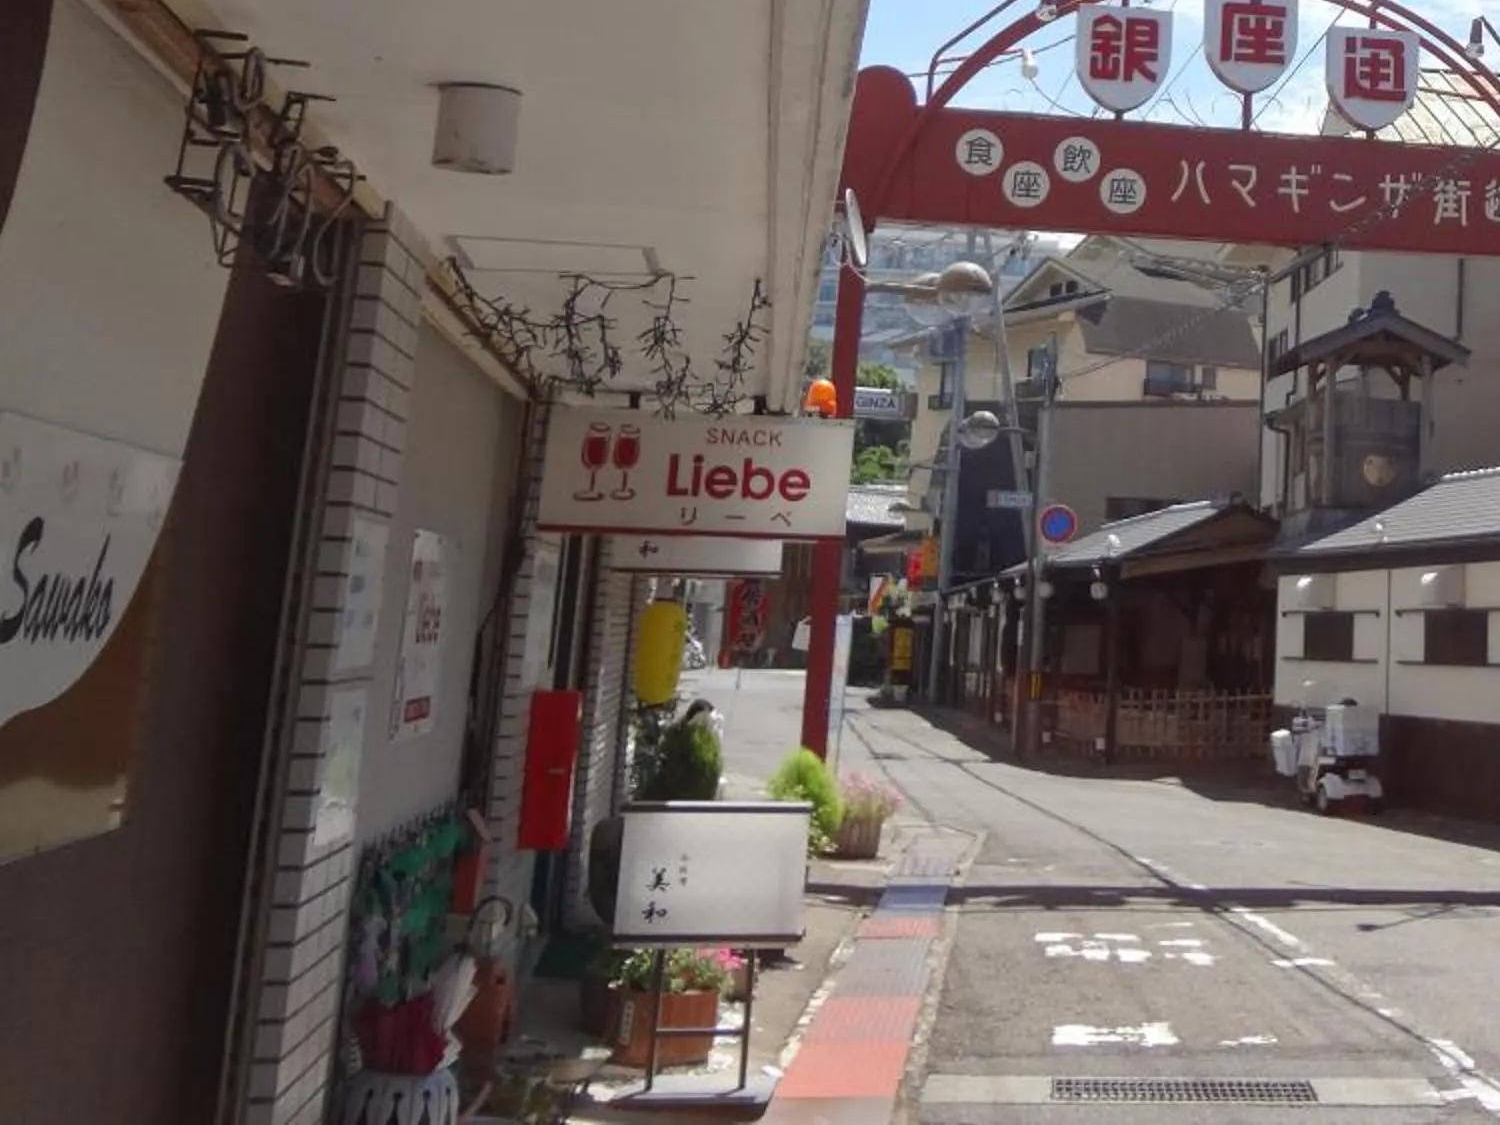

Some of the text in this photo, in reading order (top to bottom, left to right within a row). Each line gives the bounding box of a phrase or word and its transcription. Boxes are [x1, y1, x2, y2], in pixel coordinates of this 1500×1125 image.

[705, 427, 783, 448] SNACK
[666, 453, 811, 502] Liebe
[680, 506, 793, 527] リーベ
[0, 515, 113, 644] Sawako
[641, 866, 673, 924] 美和
